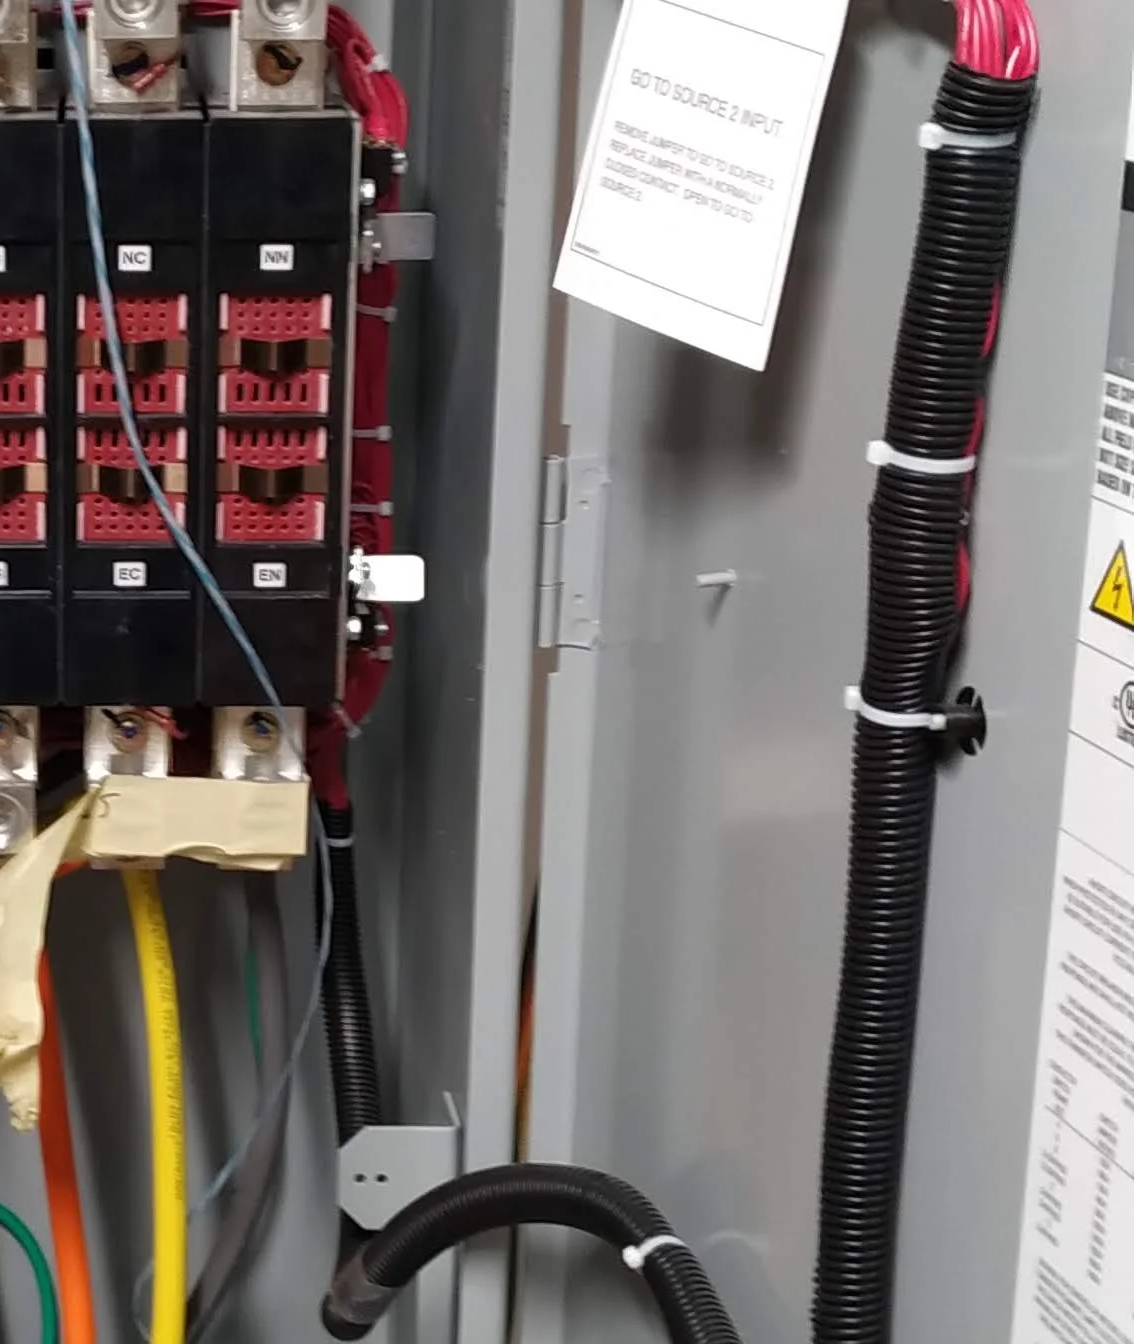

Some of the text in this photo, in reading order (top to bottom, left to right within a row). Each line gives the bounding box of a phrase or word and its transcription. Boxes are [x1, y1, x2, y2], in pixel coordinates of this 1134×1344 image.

[630, 68, 784, 137] GO TO SOURCE 2 INPUT
[123, 250, 146, 265] NC
[265, 250, 288, 265] NN
[118, 566, 141, 580] EC
[258, 567, 282, 581] EN
